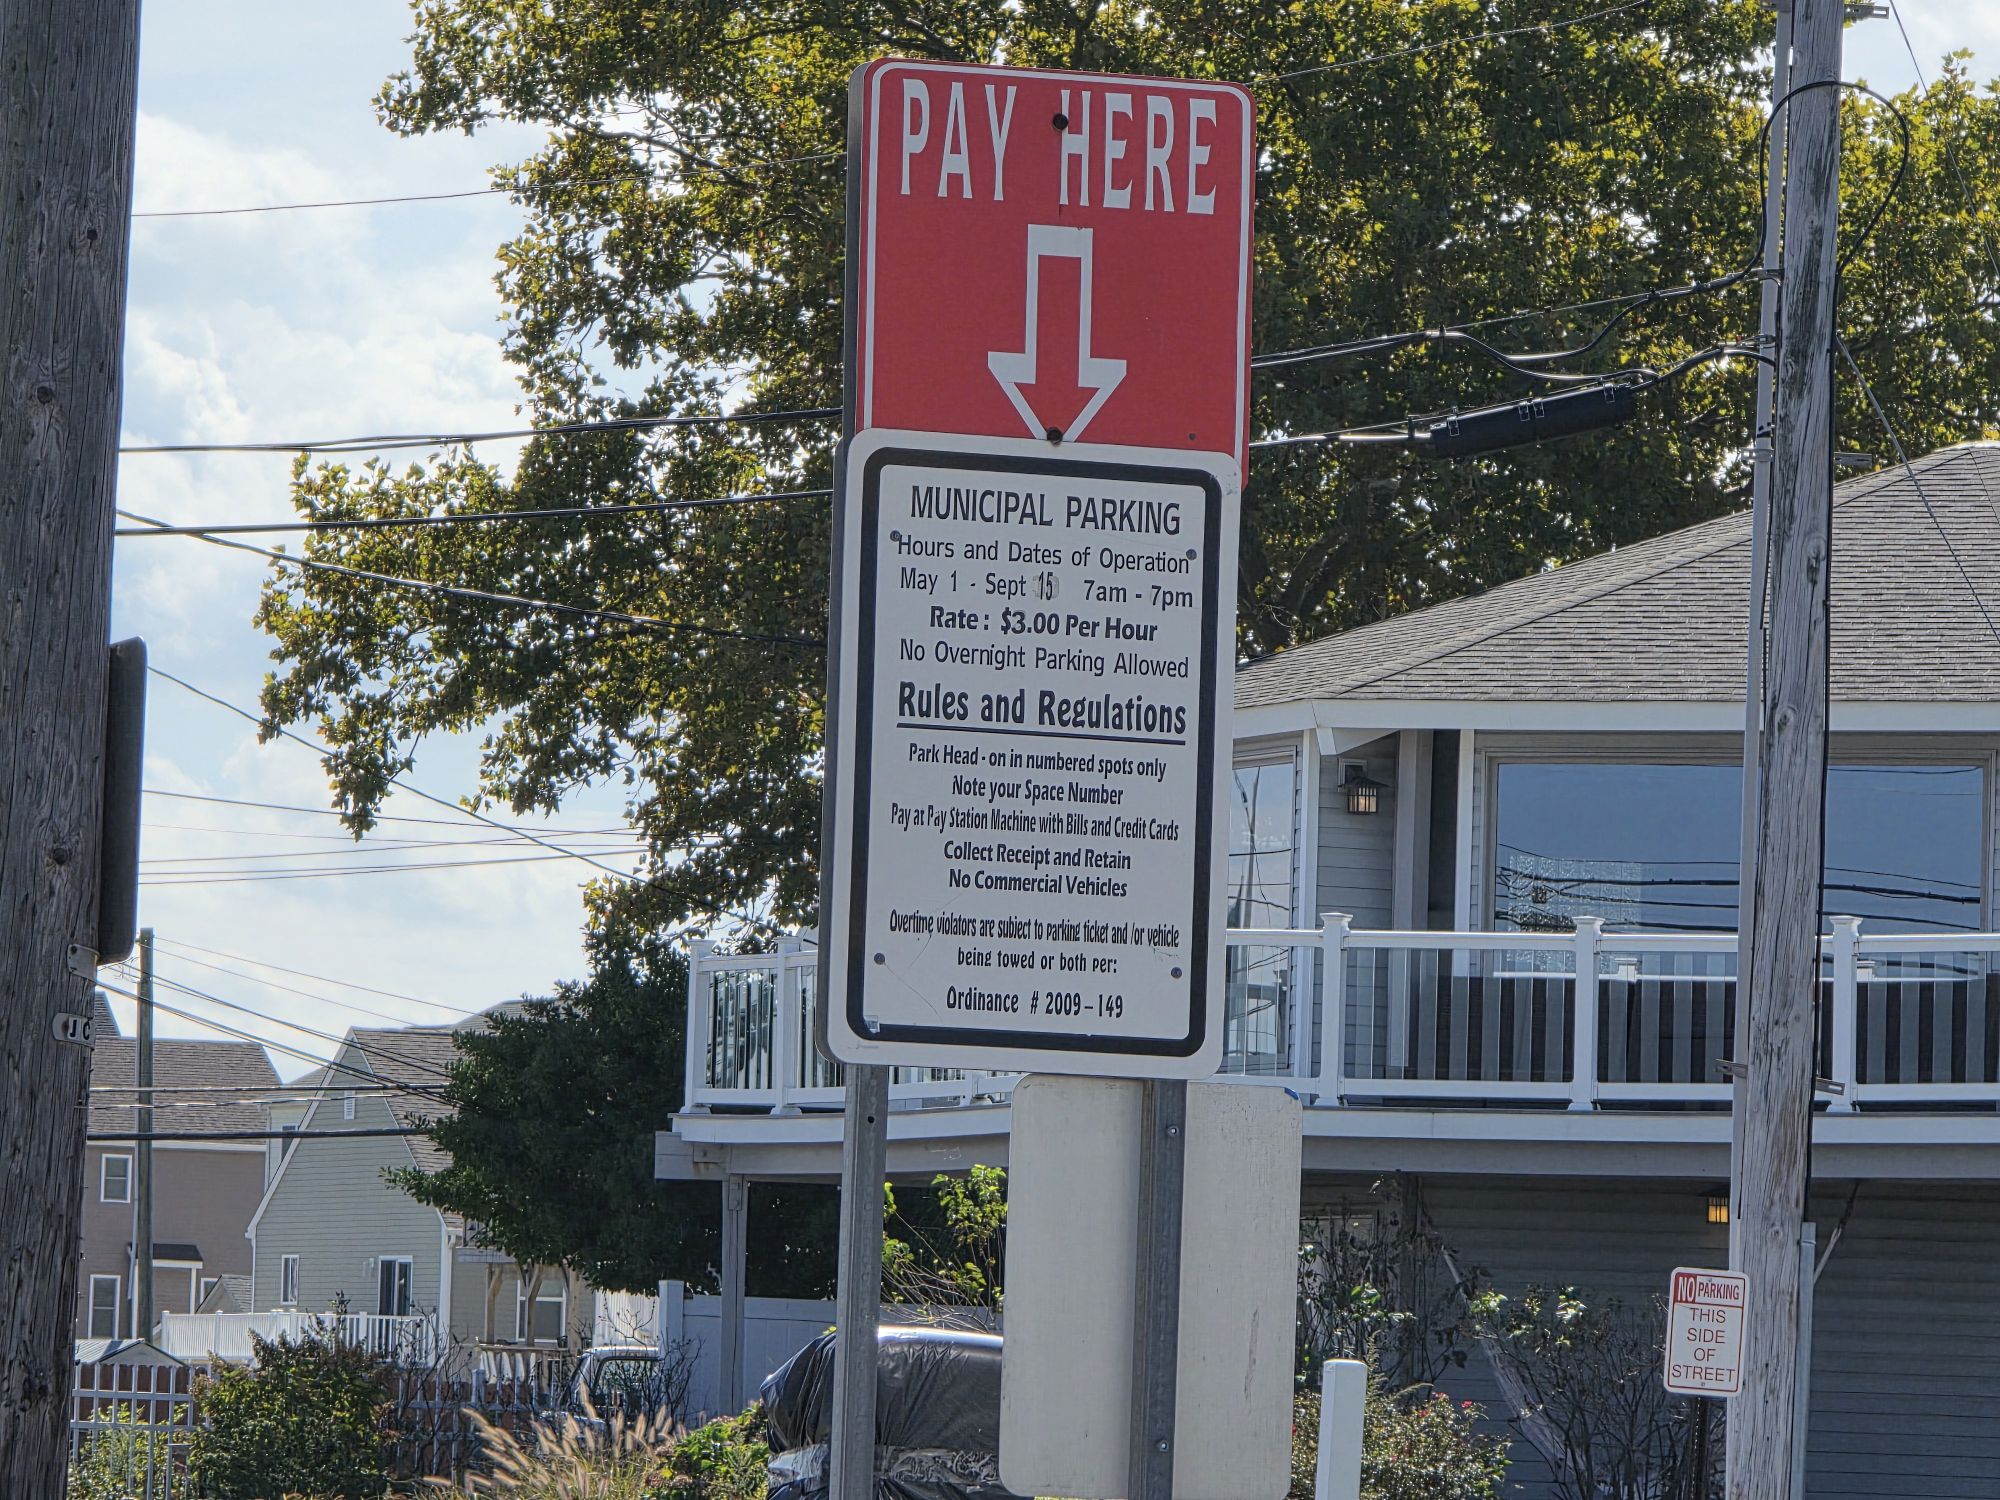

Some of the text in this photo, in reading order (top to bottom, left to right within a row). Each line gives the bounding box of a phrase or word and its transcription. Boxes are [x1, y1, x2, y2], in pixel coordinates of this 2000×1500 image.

[900, 78, 1217, 215] PAY HERE
[911, 485, 1181, 535] MUNICIPAL PARKING
[898, 535, 1189, 575] Hours and Dates of Operation
[901, 567, 938, 595] May
[951, 570, 957, 592] 1
[986, 573, 1026, 600] Sept
[1038, 571, 1055, 601] 15
[1084, 580, 1127, 603] 7am
[1152, 585, 1193, 611] 7pm
[1001, 607, 1059, 635] $3.00
[1066, 614, 1100, 638] Per
[1105, 617, 1158, 641] Hour
[901, 638, 1188, 678] No Overnight Parking Allowed
[899, 681, 1186, 734] Rules and Regulations
[909, 743, 940, 763] Park
[943, 745, 978, 765] Head
[989, 752, 1007, 767] on
[1010, 748, 1022, 768] in
[1026, 753, 1094, 773] numbered
[1098, 756, 1133, 779] spots
[1137, 758, 1166, 782] only
[952, 775, 1123, 806] Note your Space Number
[891, 803, 1178, 841] Pay at Pay Station Machine with Bills and Credit Cards
[944, 840, 1131, 870] Collect Receipt and Retain
[949, 868, 1127, 897] No Commercial Vehicles
[890, 909, 934, 936] Overtime
[937, 912, 976, 937] violators
[980, 919, 995, 938] are
[998, 916, 1031, 940] subject
[1034, 919, 1043, 941] to
[1047, 920, 1080, 943] parking
[1083, 920, 1109, 945] ticket
[1112, 922, 1127, 945] and
[1148, 924, 1179, 948] vehicle
[958, 947, 1117, 974] being towed or both per:
[947, 986, 1018, 1013] Ordinance
[1031, 991, 1039, 1014] #
[1677, 1276, 1740, 1302] NO PARKING
[1690, 1307, 1726, 1323] THIS
[1687, 1328, 1726, 1344] SIDE
[1694, 1348, 1716, 1361] OF
[1672, 1364, 1736, 1382] STREET
